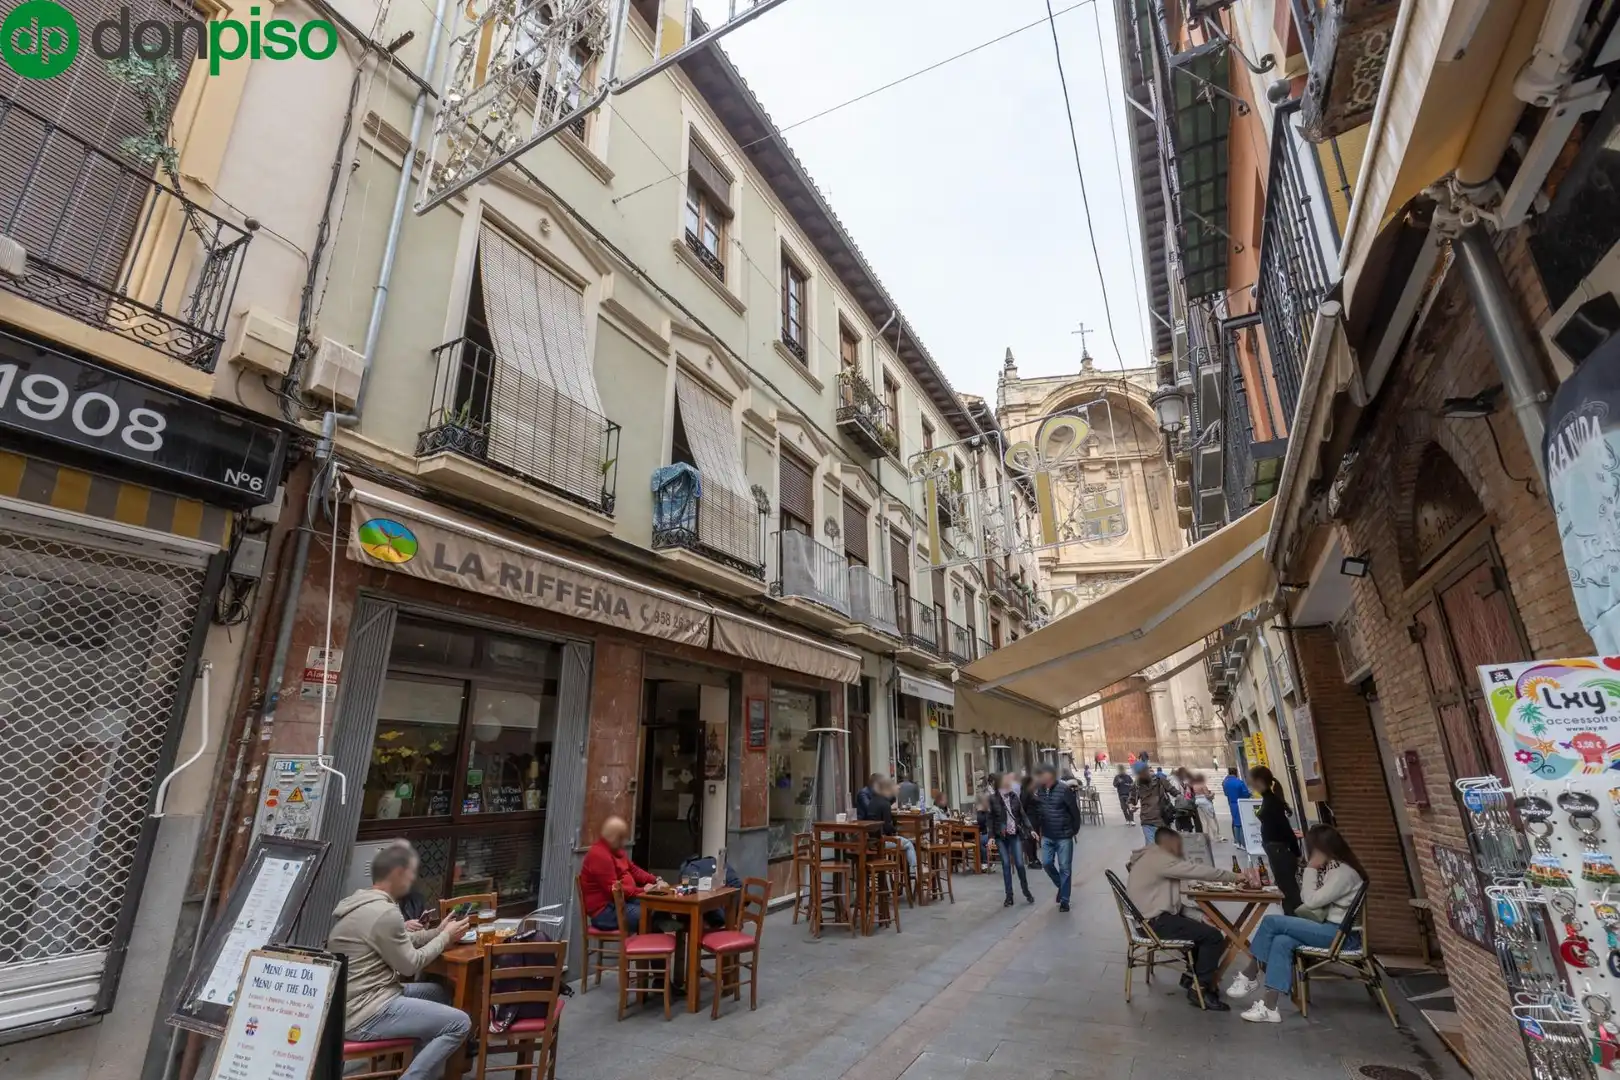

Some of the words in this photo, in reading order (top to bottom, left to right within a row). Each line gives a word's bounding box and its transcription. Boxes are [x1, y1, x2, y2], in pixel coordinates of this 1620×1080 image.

[0, 363, 167, 452] 1908
[433, 542, 486, 582] LA
[500, 561, 631, 620] RIFFEÑA
[654, 610, 671, 626] 958
